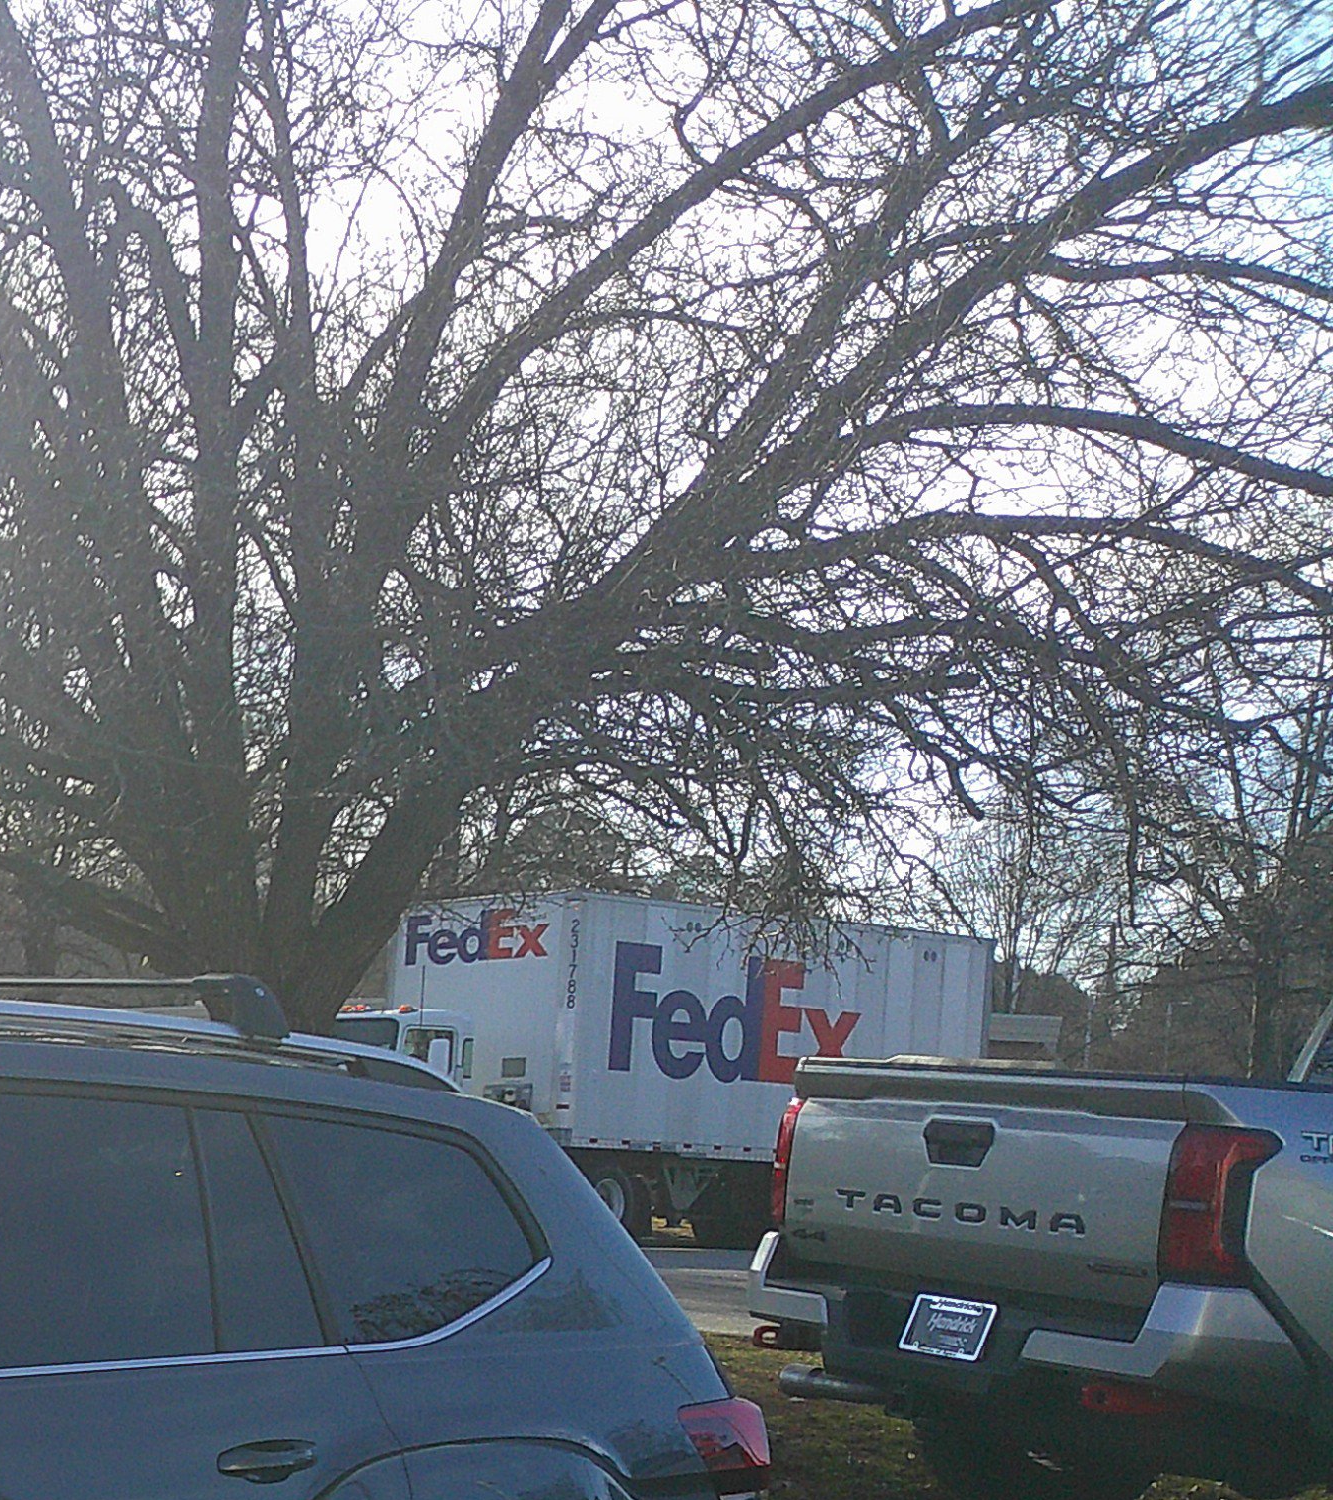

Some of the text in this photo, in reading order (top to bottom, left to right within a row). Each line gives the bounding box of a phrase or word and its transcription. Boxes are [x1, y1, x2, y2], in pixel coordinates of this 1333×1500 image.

[405, 909, 550, 966] FedEx
[566, 918, 581, 1010] 231788
[608, 940, 861, 1084] FedEx
[836, 1189, 1085, 1238] TACOMA
